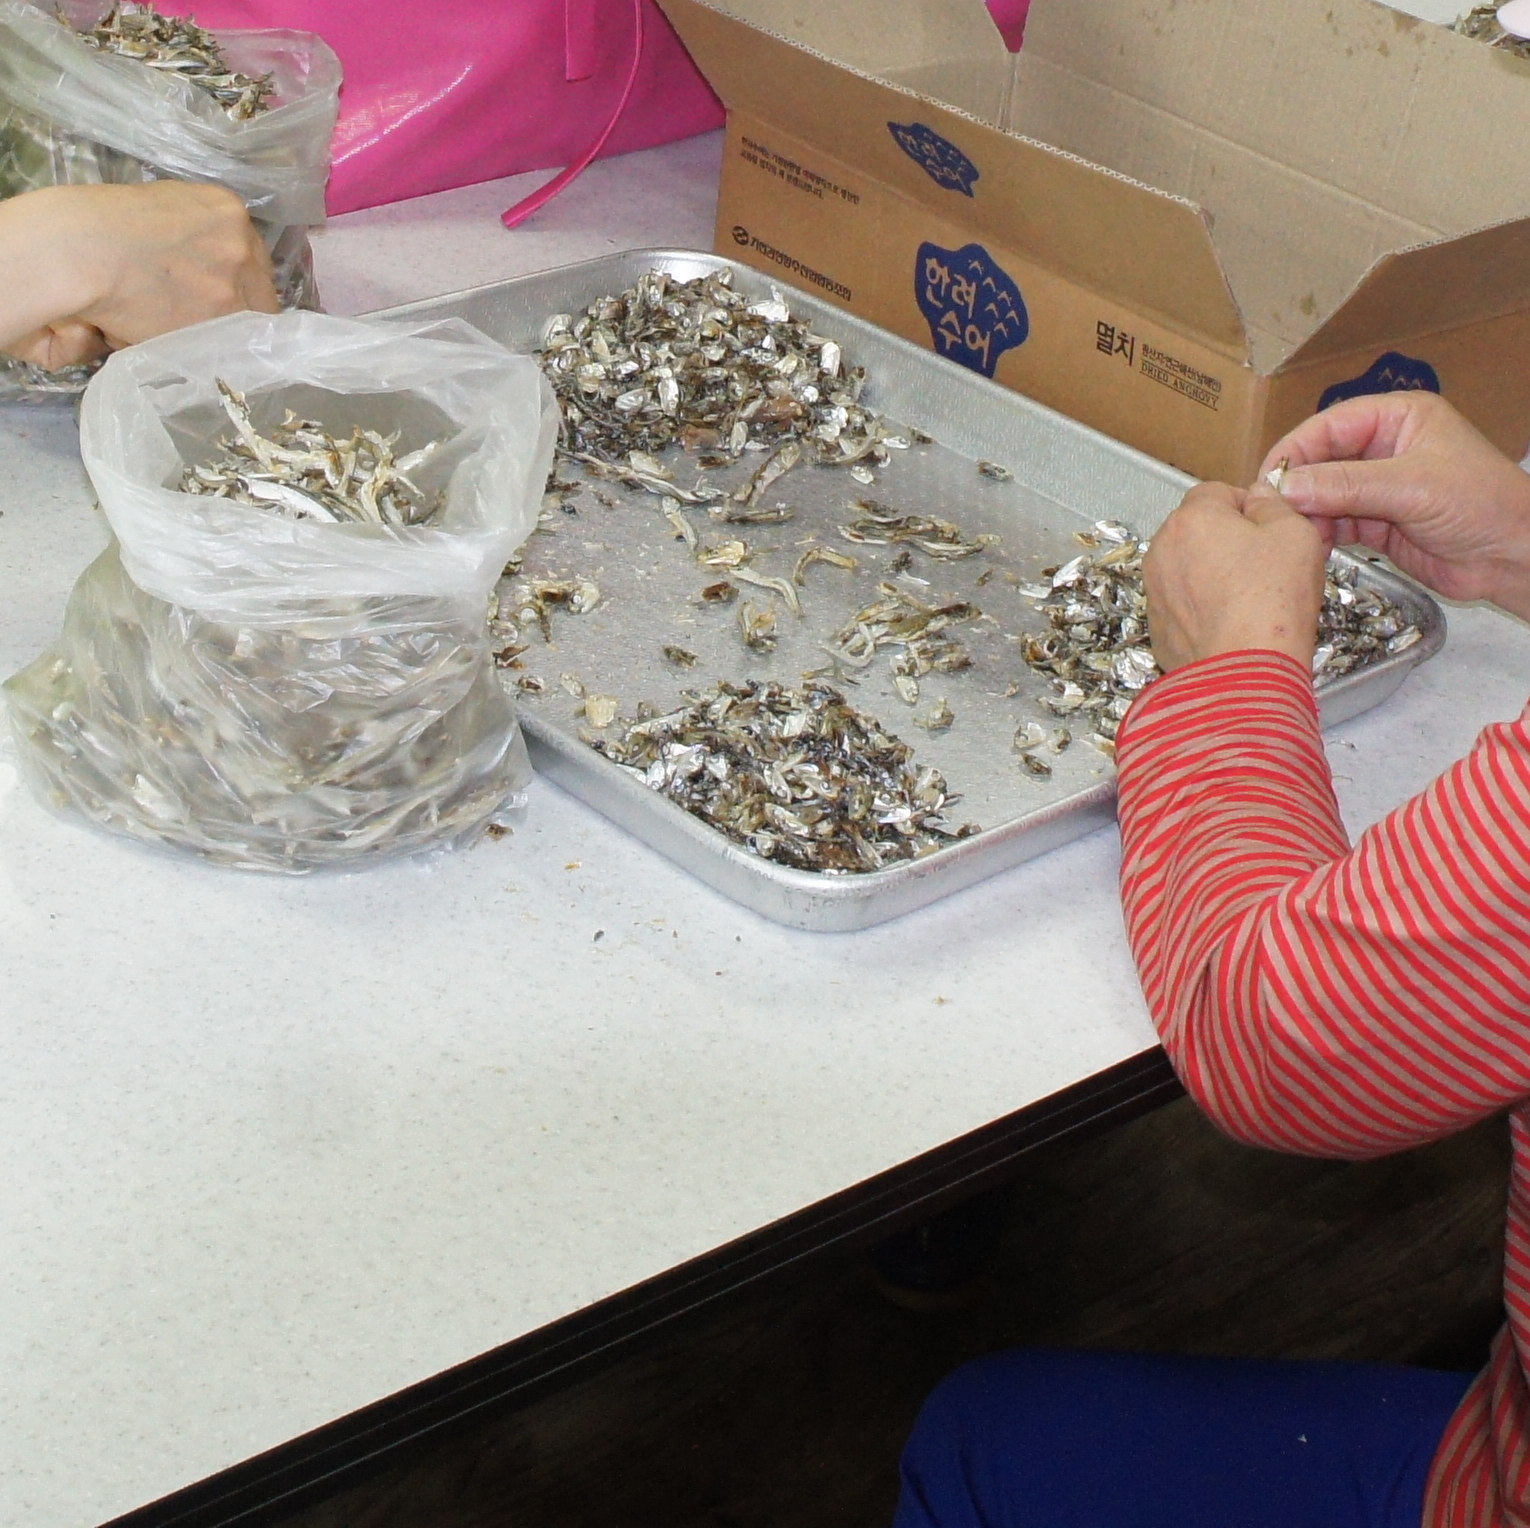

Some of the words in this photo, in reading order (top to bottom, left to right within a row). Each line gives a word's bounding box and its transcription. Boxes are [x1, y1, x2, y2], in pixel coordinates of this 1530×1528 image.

[925, 257, 977, 320] 한려
[937, 310, 991, 369] 수어
[1095, 320, 1134, 367] 멸치
[1141, 361, 1169, 383] DRIED
[1172, 378, 1218, 408] ANCHOVY
